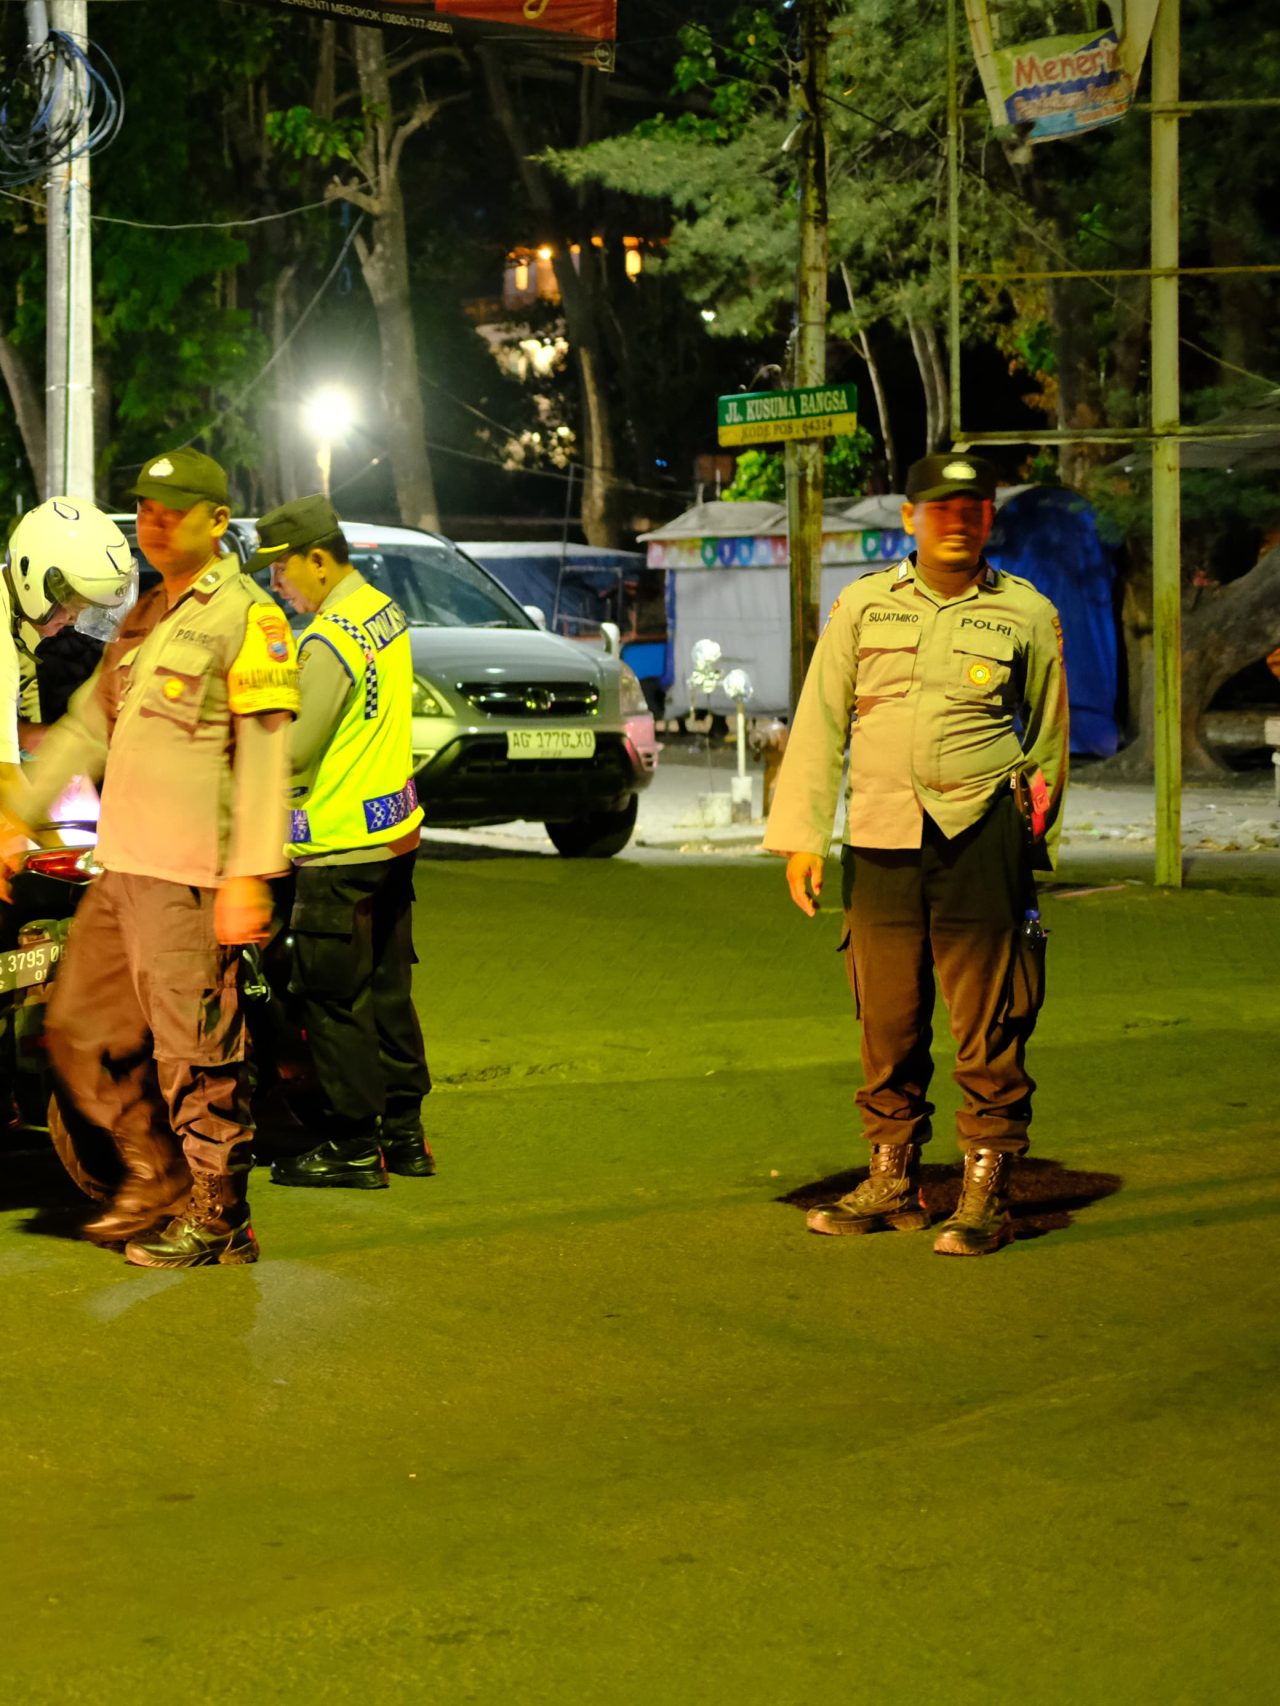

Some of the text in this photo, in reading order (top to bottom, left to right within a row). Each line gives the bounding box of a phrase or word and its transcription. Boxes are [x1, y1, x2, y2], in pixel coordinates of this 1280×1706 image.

[330, 3, 381, 21] MEROKOK
[1014, 38, 1118, 88] Meneri
[746, 395, 796, 421] KUSUMA
[800, 389, 848, 415] BANGSA
[868, 611, 919, 624] SUJATMIKO
[960, 617, 1012, 637] POLRI
[513, 732, 531, 749] AG
[7, 948, 46, 973] 3795
